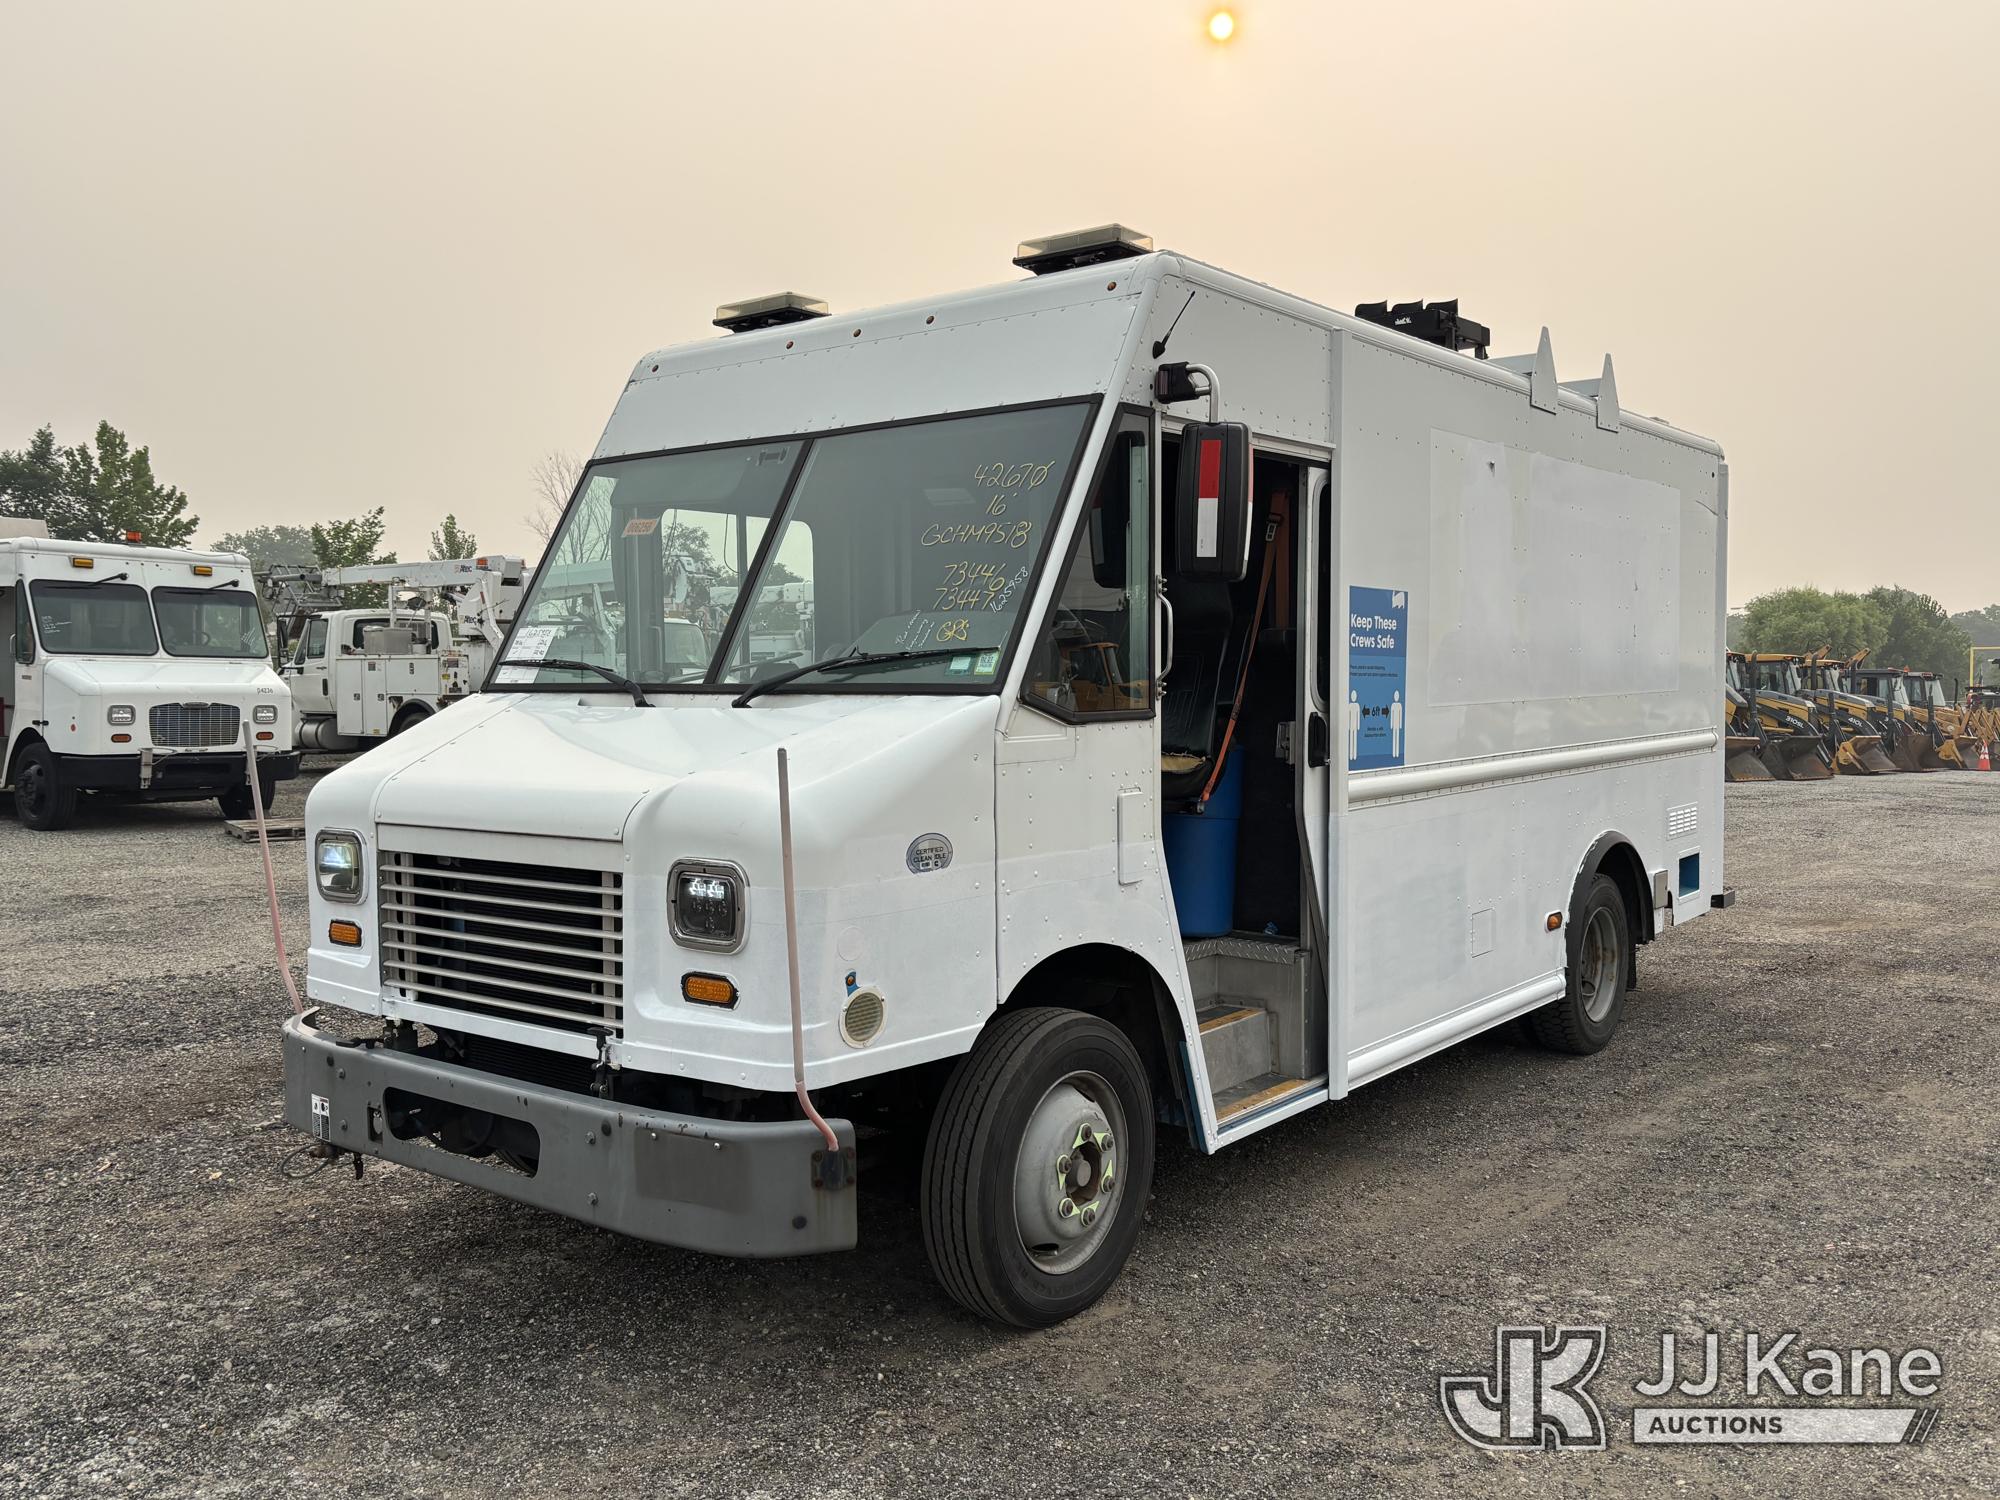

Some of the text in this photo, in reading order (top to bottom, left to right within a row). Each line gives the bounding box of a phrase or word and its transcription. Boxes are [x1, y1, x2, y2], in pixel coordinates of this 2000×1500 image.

[944, 561, 1006, 591] 73446
[932, 588, 995, 611] 73447
[1350, 613, 1398, 631] Keep These
[1350, 633, 1395, 649] Crews Safe
[1371, 705, 1381, 717] 6ft
[913, 855, 933, 863] CLEAN
[915, 846, 944, 856] CERTIFIED
